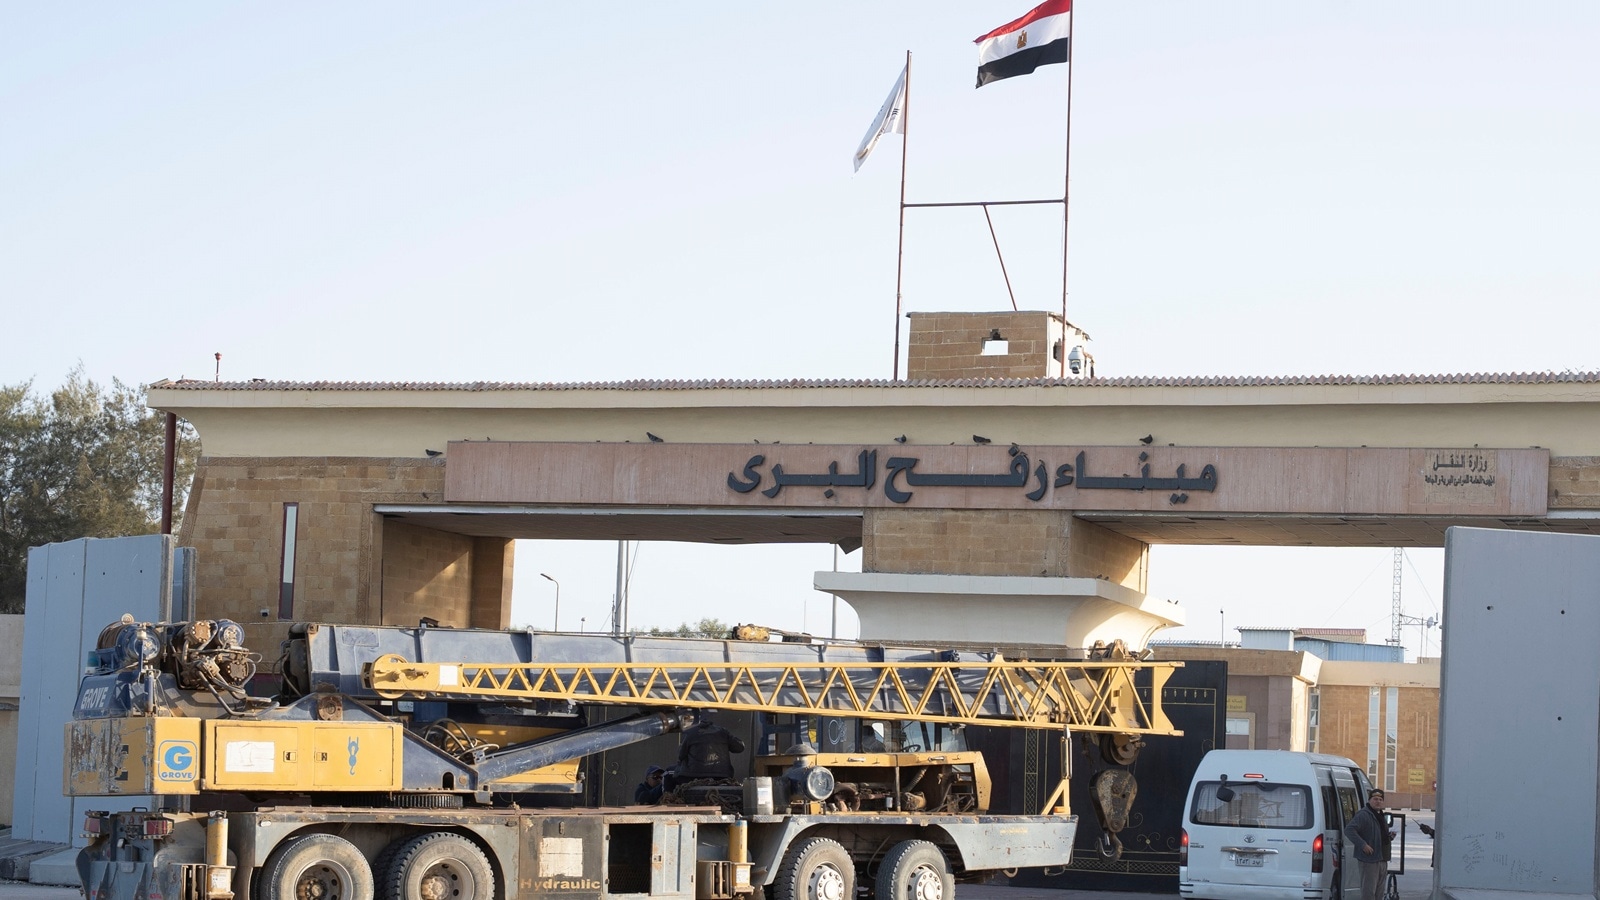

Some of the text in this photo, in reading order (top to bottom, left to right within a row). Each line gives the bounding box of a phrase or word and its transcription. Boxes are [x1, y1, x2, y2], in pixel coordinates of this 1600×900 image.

[885, 445, 1047, 502] رفح
[1433, 454, 1487, 472] وزارة النقل
[1054, 450, 1217, 503] ميناء
[81, 687, 109, 709] GROVE
[520, 878, 601, 891] Hydraulic
